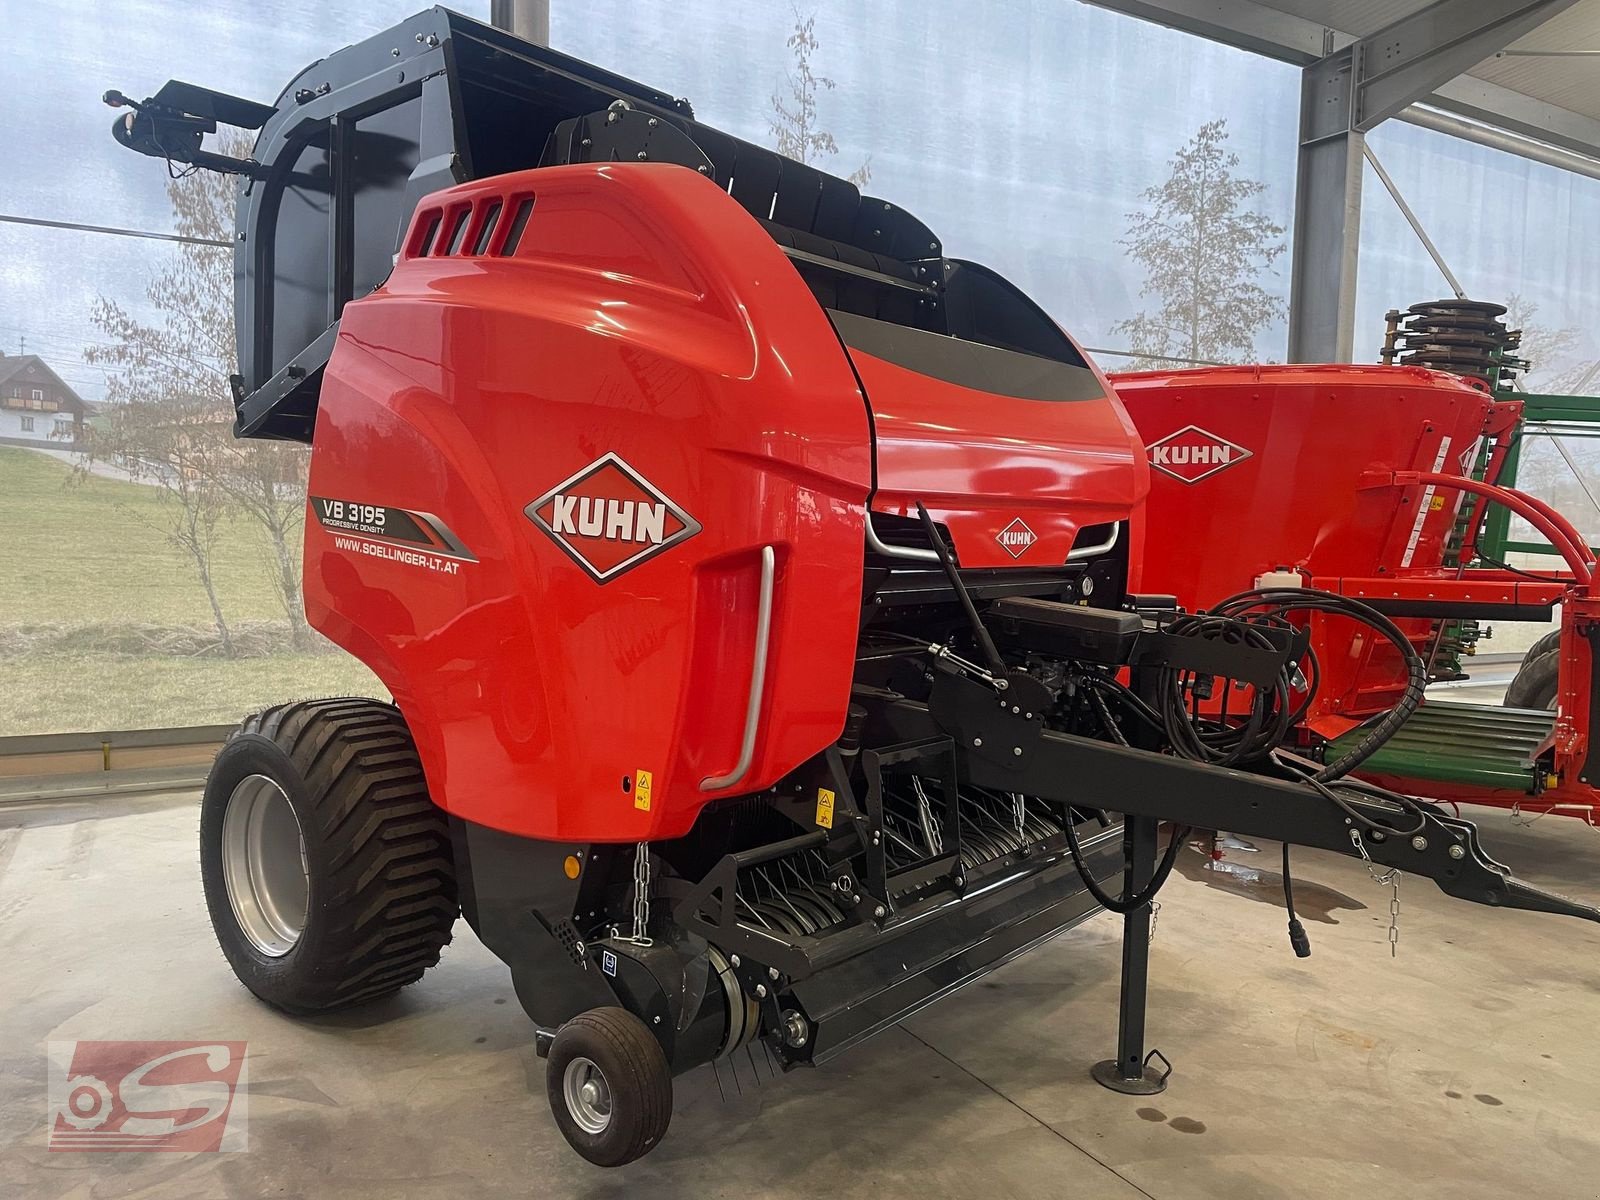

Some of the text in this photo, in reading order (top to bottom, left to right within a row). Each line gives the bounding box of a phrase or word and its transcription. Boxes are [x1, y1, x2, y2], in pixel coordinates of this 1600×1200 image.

[1153, 446, 1230, 464] KUHN
[323, 500, 386, 526] VB 3195
[552, 494, 666, 545] KUHN
[322, 518, 385, 535] PROGRESSIVE DENSITY
[1003, 531, 1031, 545] KUHN
